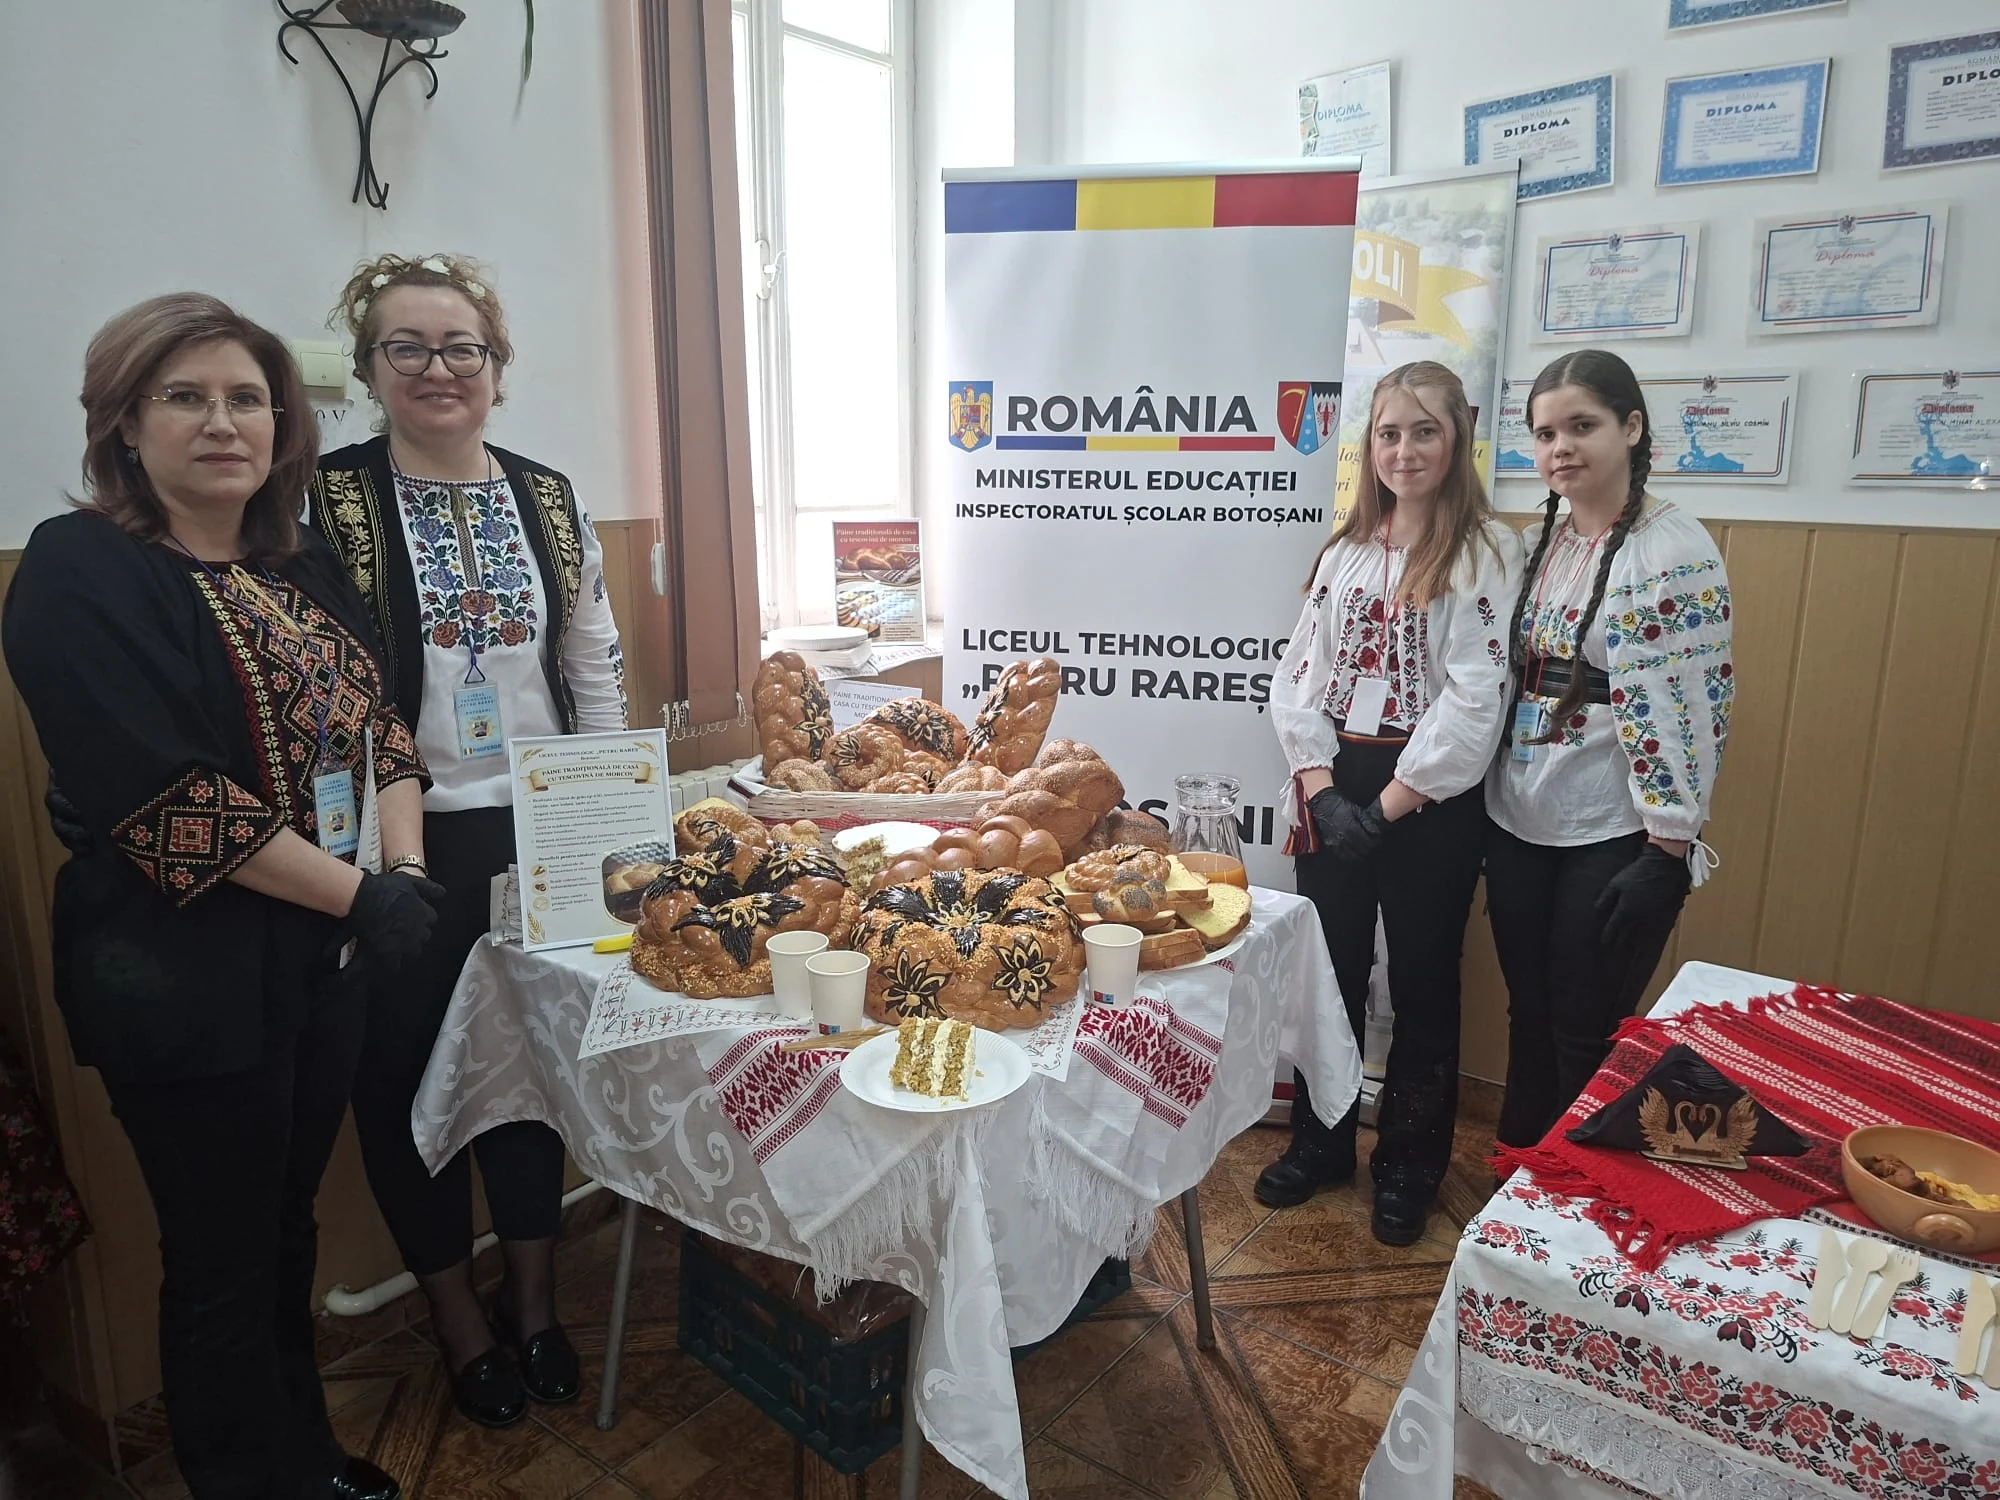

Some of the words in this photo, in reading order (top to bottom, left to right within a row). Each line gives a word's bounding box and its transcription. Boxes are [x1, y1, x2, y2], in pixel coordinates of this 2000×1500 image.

[1317, 103, 1363, 121] DIPLOMA
[1706, 102, 1777, 118] DIPLOMA
[1503, 118, 1571, 138] DIPLOMA
[1815, 248, 1876, 265] Diploma
[1007, 385, 1258, 433] ROMÂNIA
[976, 469, 1138, 491] MINISTERUL
[1147, 470, 1297, 498] EDUCAȚIEI
[956, 503, 1118, 521] INSPECTORATUL
[1123, 506, 1207, 526] ȘCOLAR
[1213, 507, 1323, 528] BOTOȘANI
[963, 628, 1070, 654] LICEUL
[1078, 631, 1291, 662] TEHNOLOGIC
[852, 693, 893, 704] TRADITIONA
